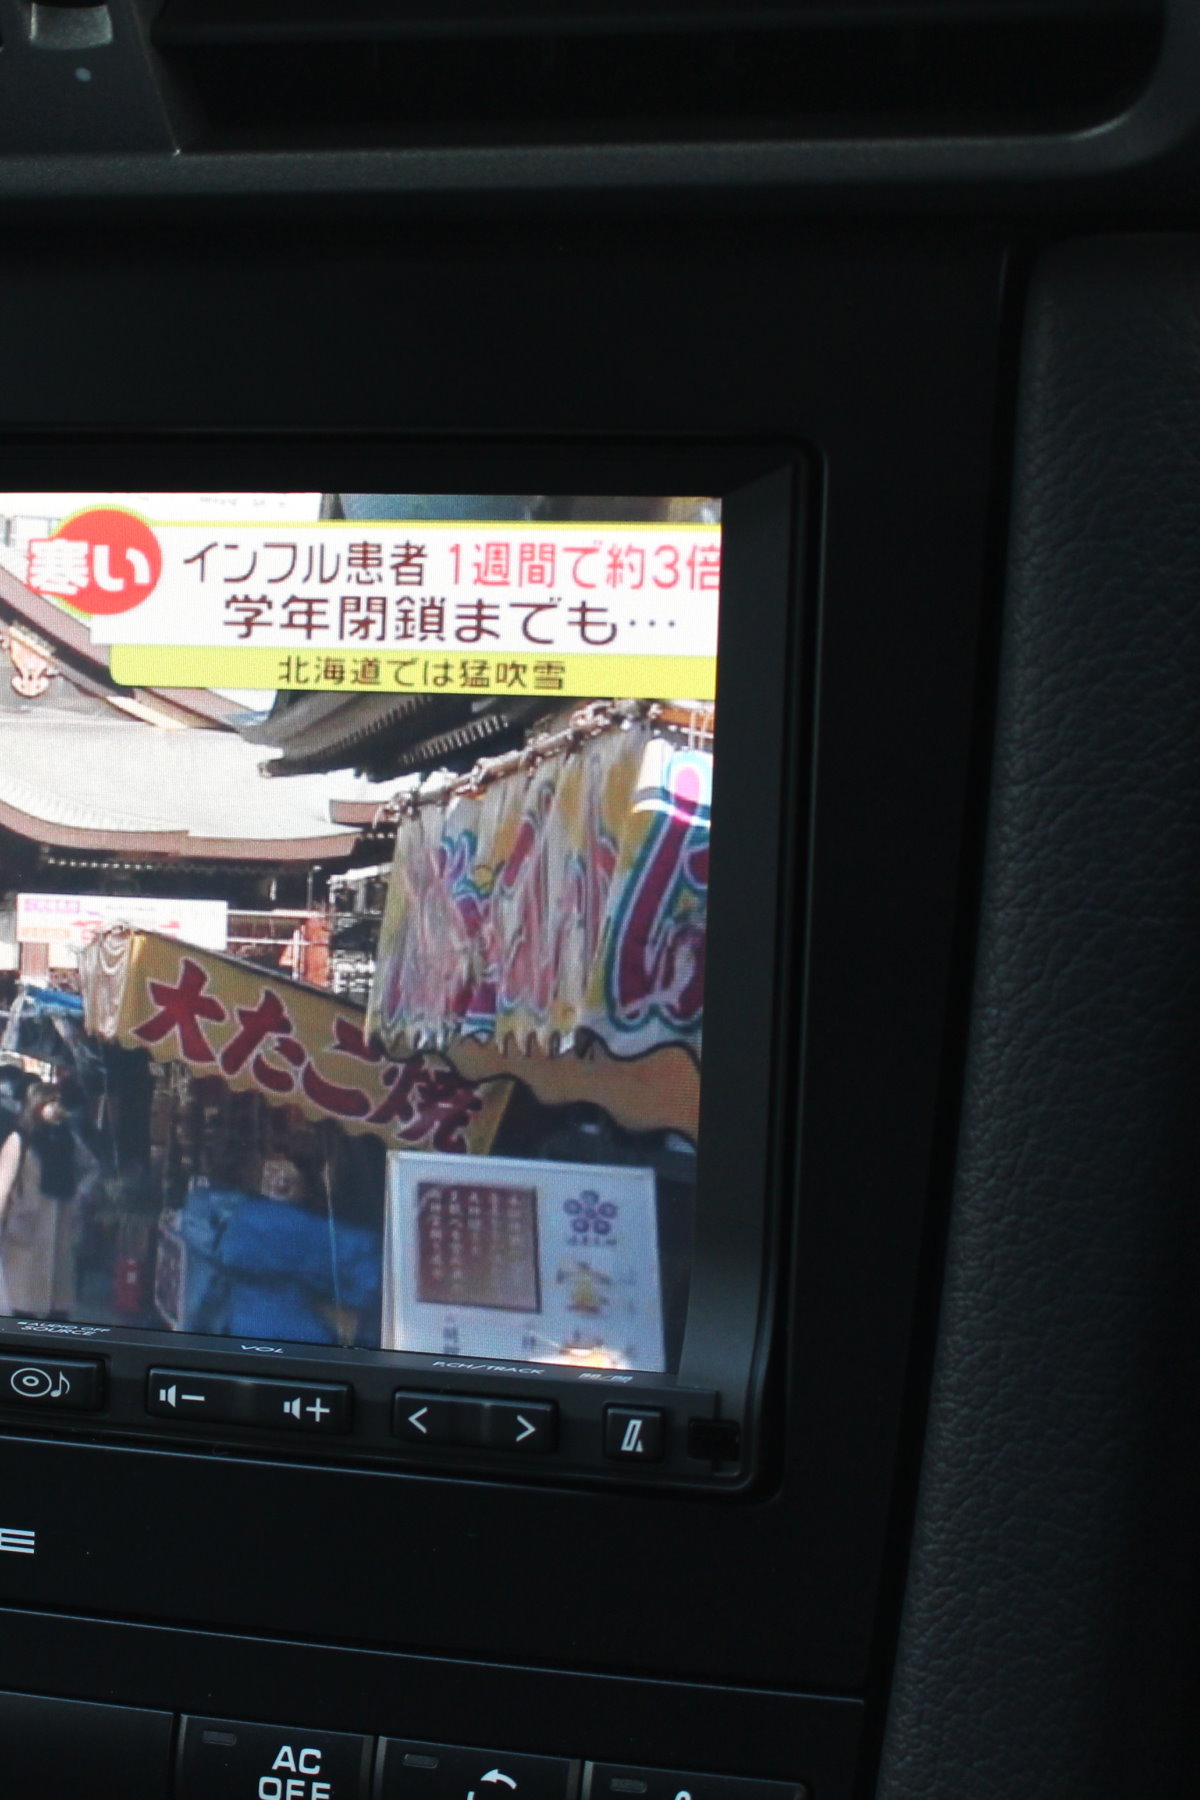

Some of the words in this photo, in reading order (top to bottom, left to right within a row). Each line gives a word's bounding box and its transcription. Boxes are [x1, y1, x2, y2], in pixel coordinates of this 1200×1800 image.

[28, 539, 151, 595] 寒い
[183, 540, 427, 587] インフル患者
[449, 541, 720, 591] 1週間で約3倍
[278, 655, 567, 690] 北海道では猛吹雪
[20, 1325, 97, 1337] SOURCE
[241, 1345, 284, 1355] VOL
[272, 1745, 322, 1775] AC
[258, 1776, 332, 1800] OFF
